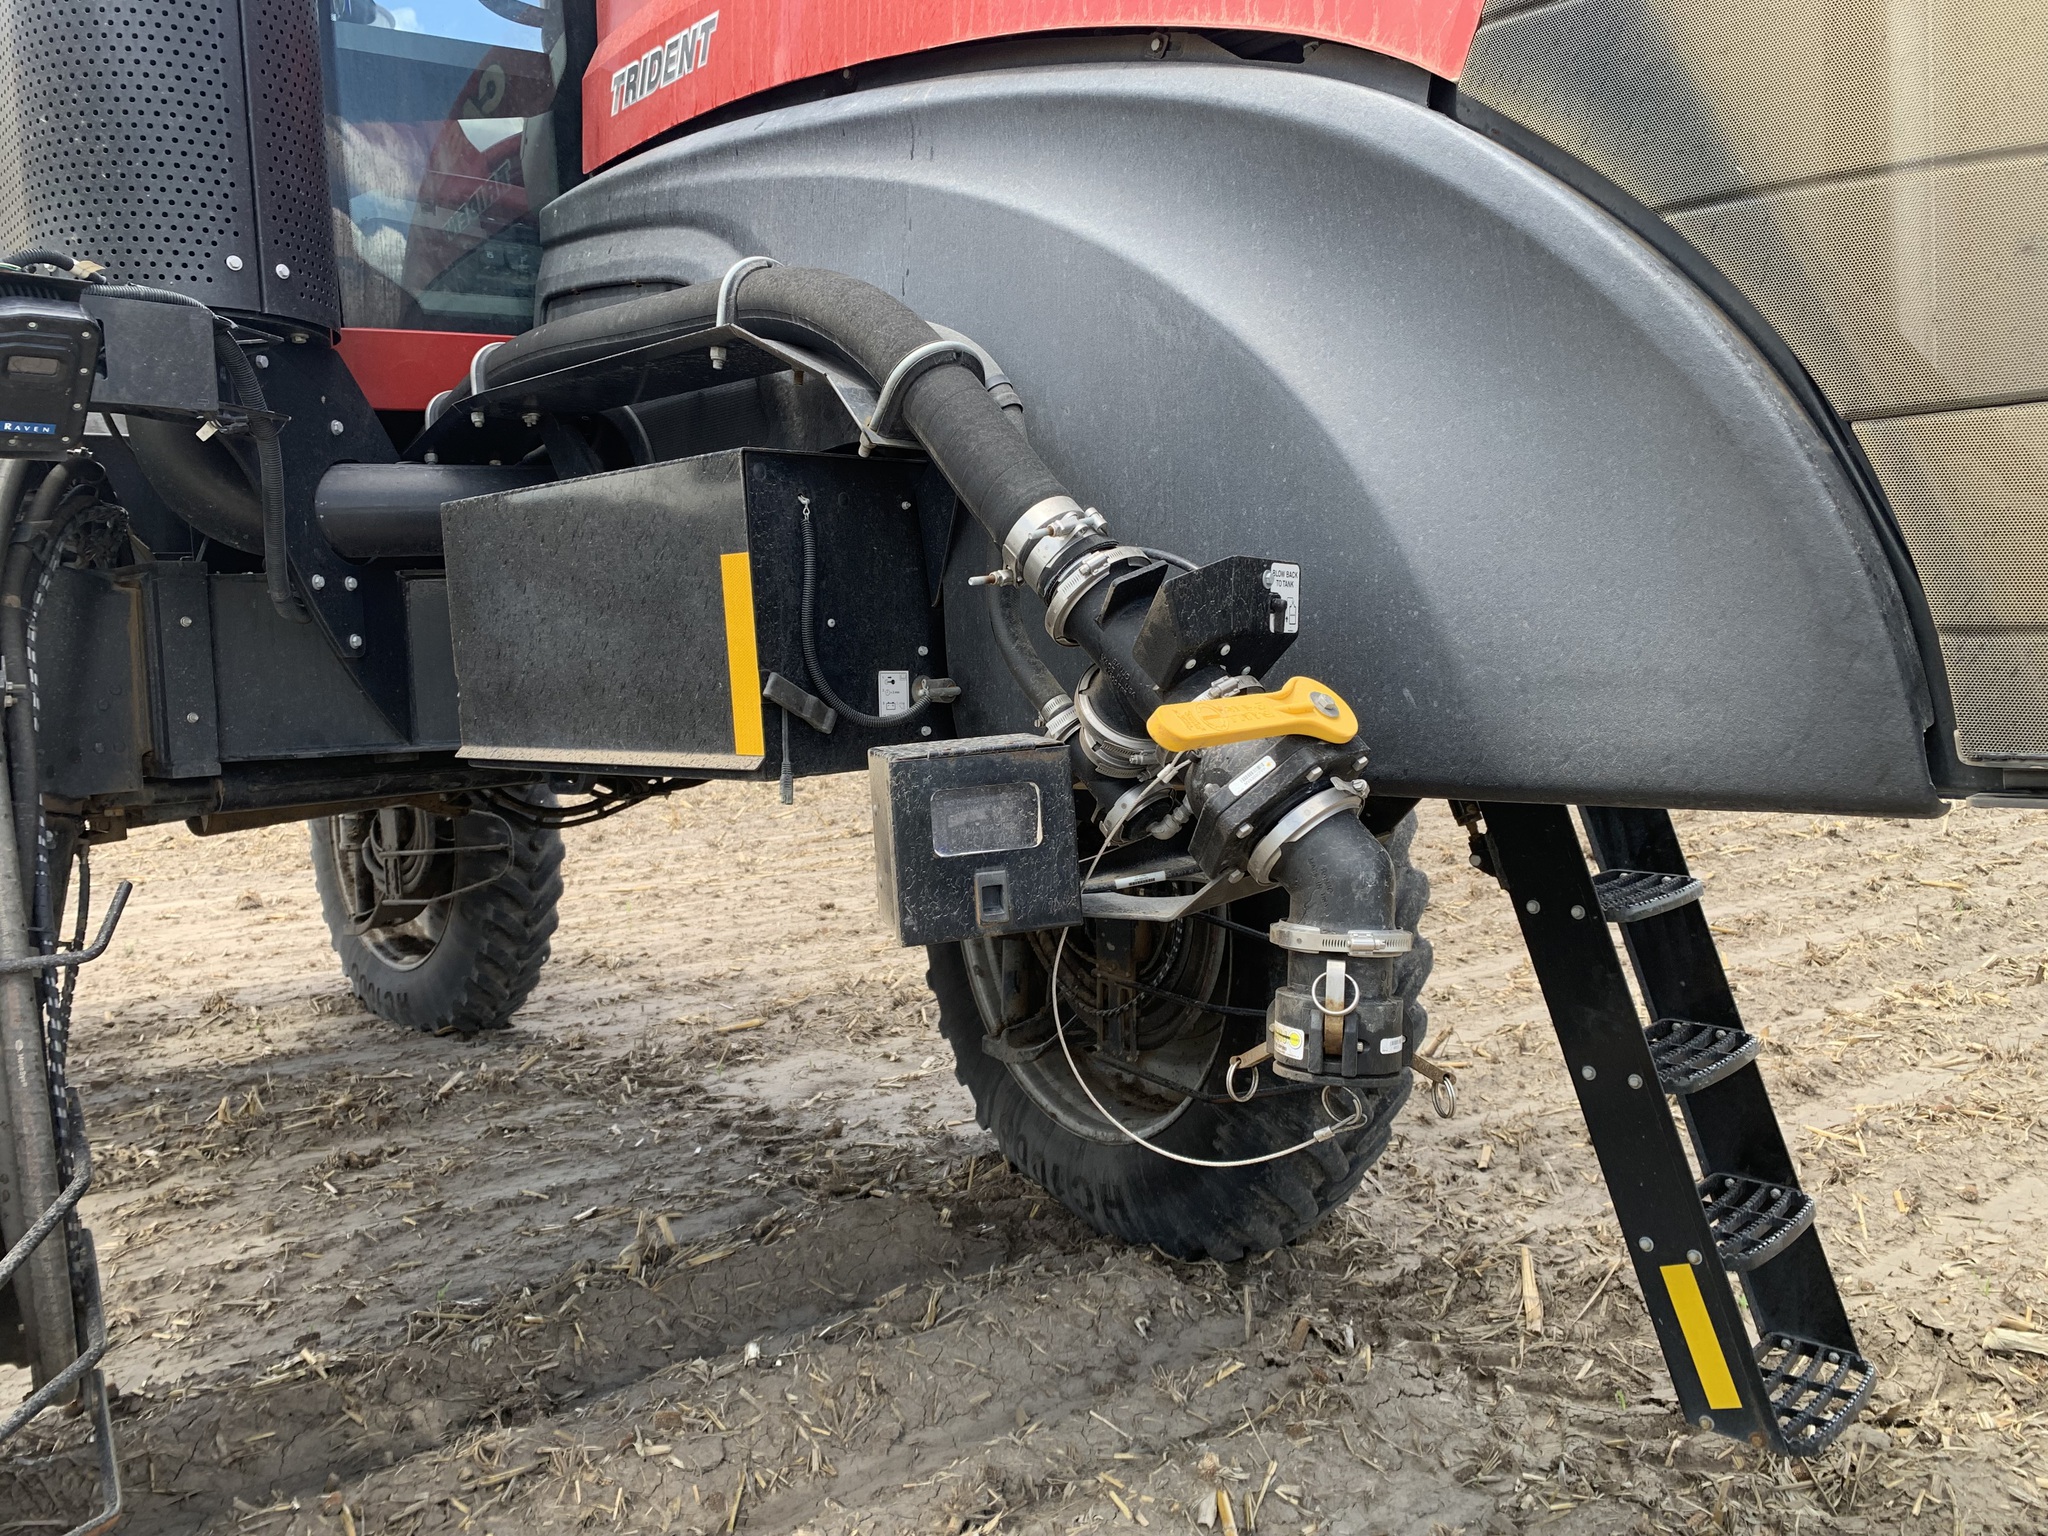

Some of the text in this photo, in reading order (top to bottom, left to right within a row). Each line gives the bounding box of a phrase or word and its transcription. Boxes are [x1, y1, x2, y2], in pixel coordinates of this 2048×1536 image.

[611, 10, 720, 117] TRIDENT
[4, 422, 50, 433] RAVEN
[1273, 569, 1298, 579] BLOW BACK
[1276, 580, 1294, 588] TO TANK
